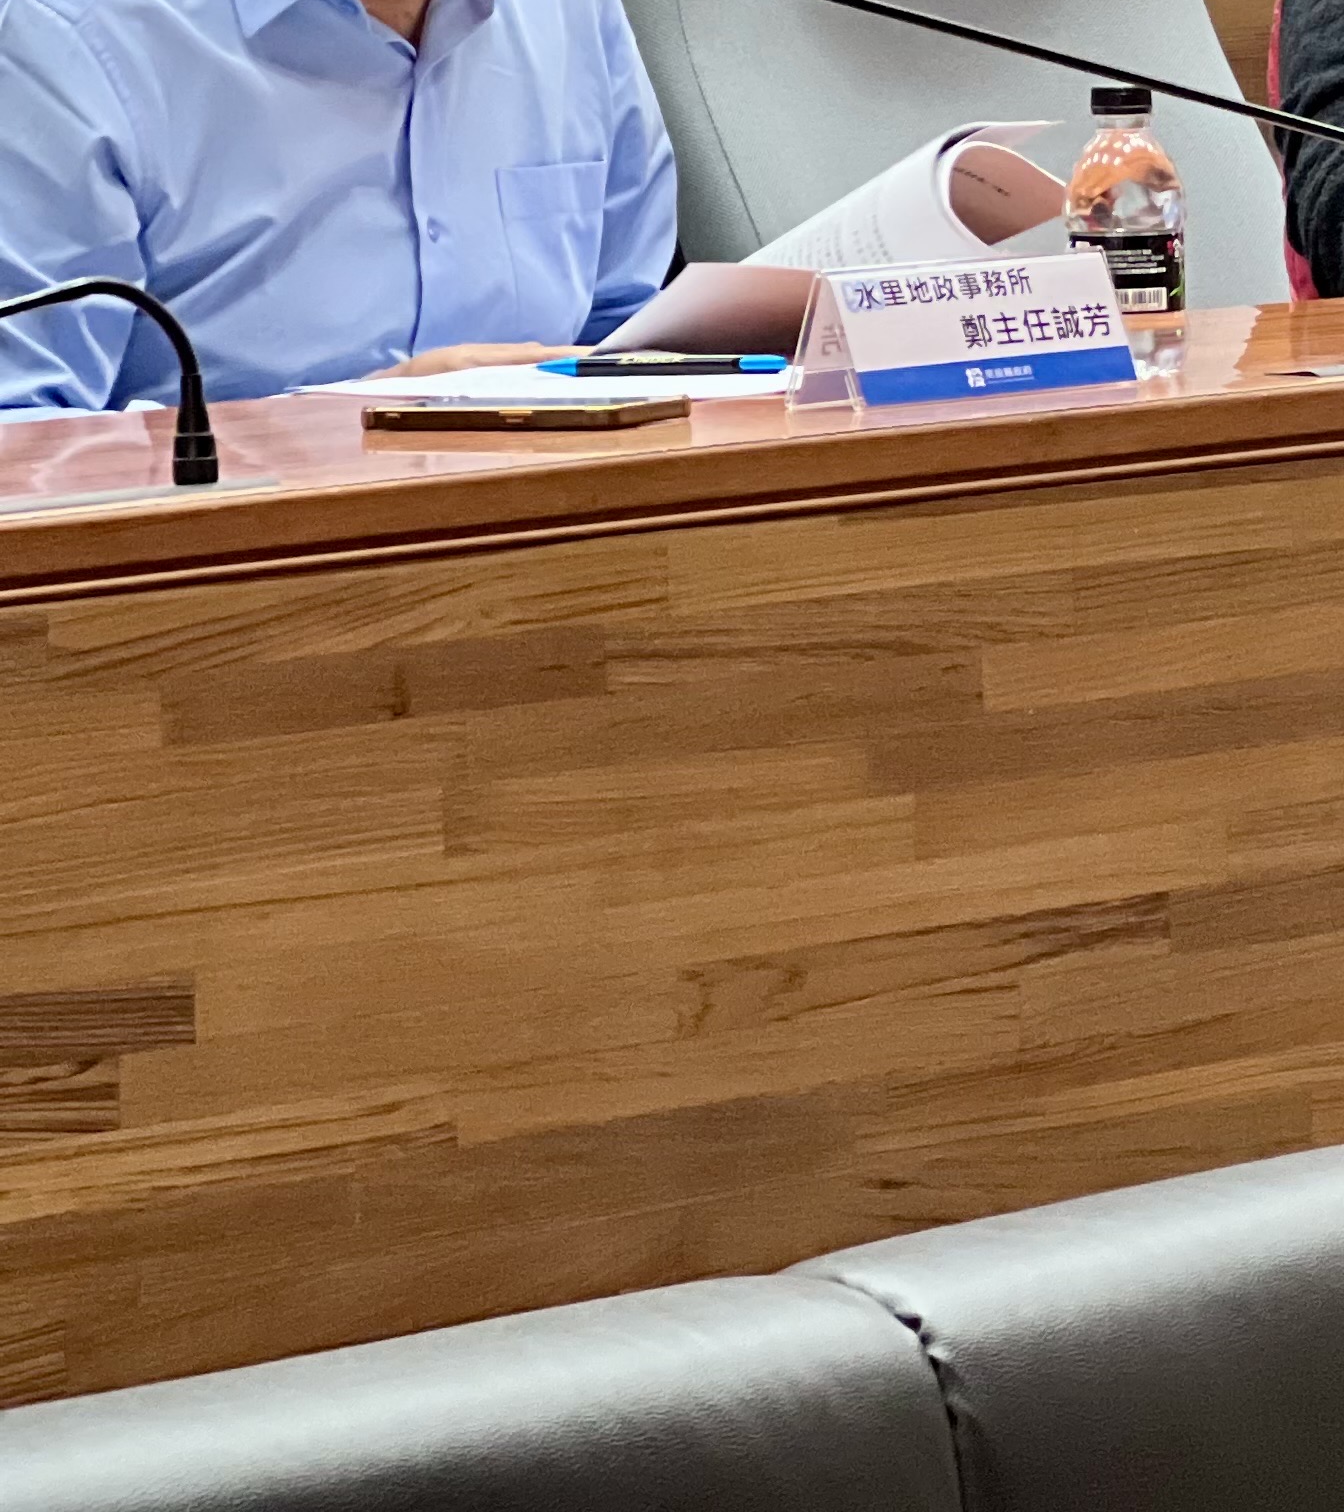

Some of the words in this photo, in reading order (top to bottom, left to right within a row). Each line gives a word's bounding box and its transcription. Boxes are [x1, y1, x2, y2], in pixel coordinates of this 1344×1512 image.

[854, 266, 1033, 310] 水里地政事務所
[960, 302, 1112, 349] 鄭主任誠芳
